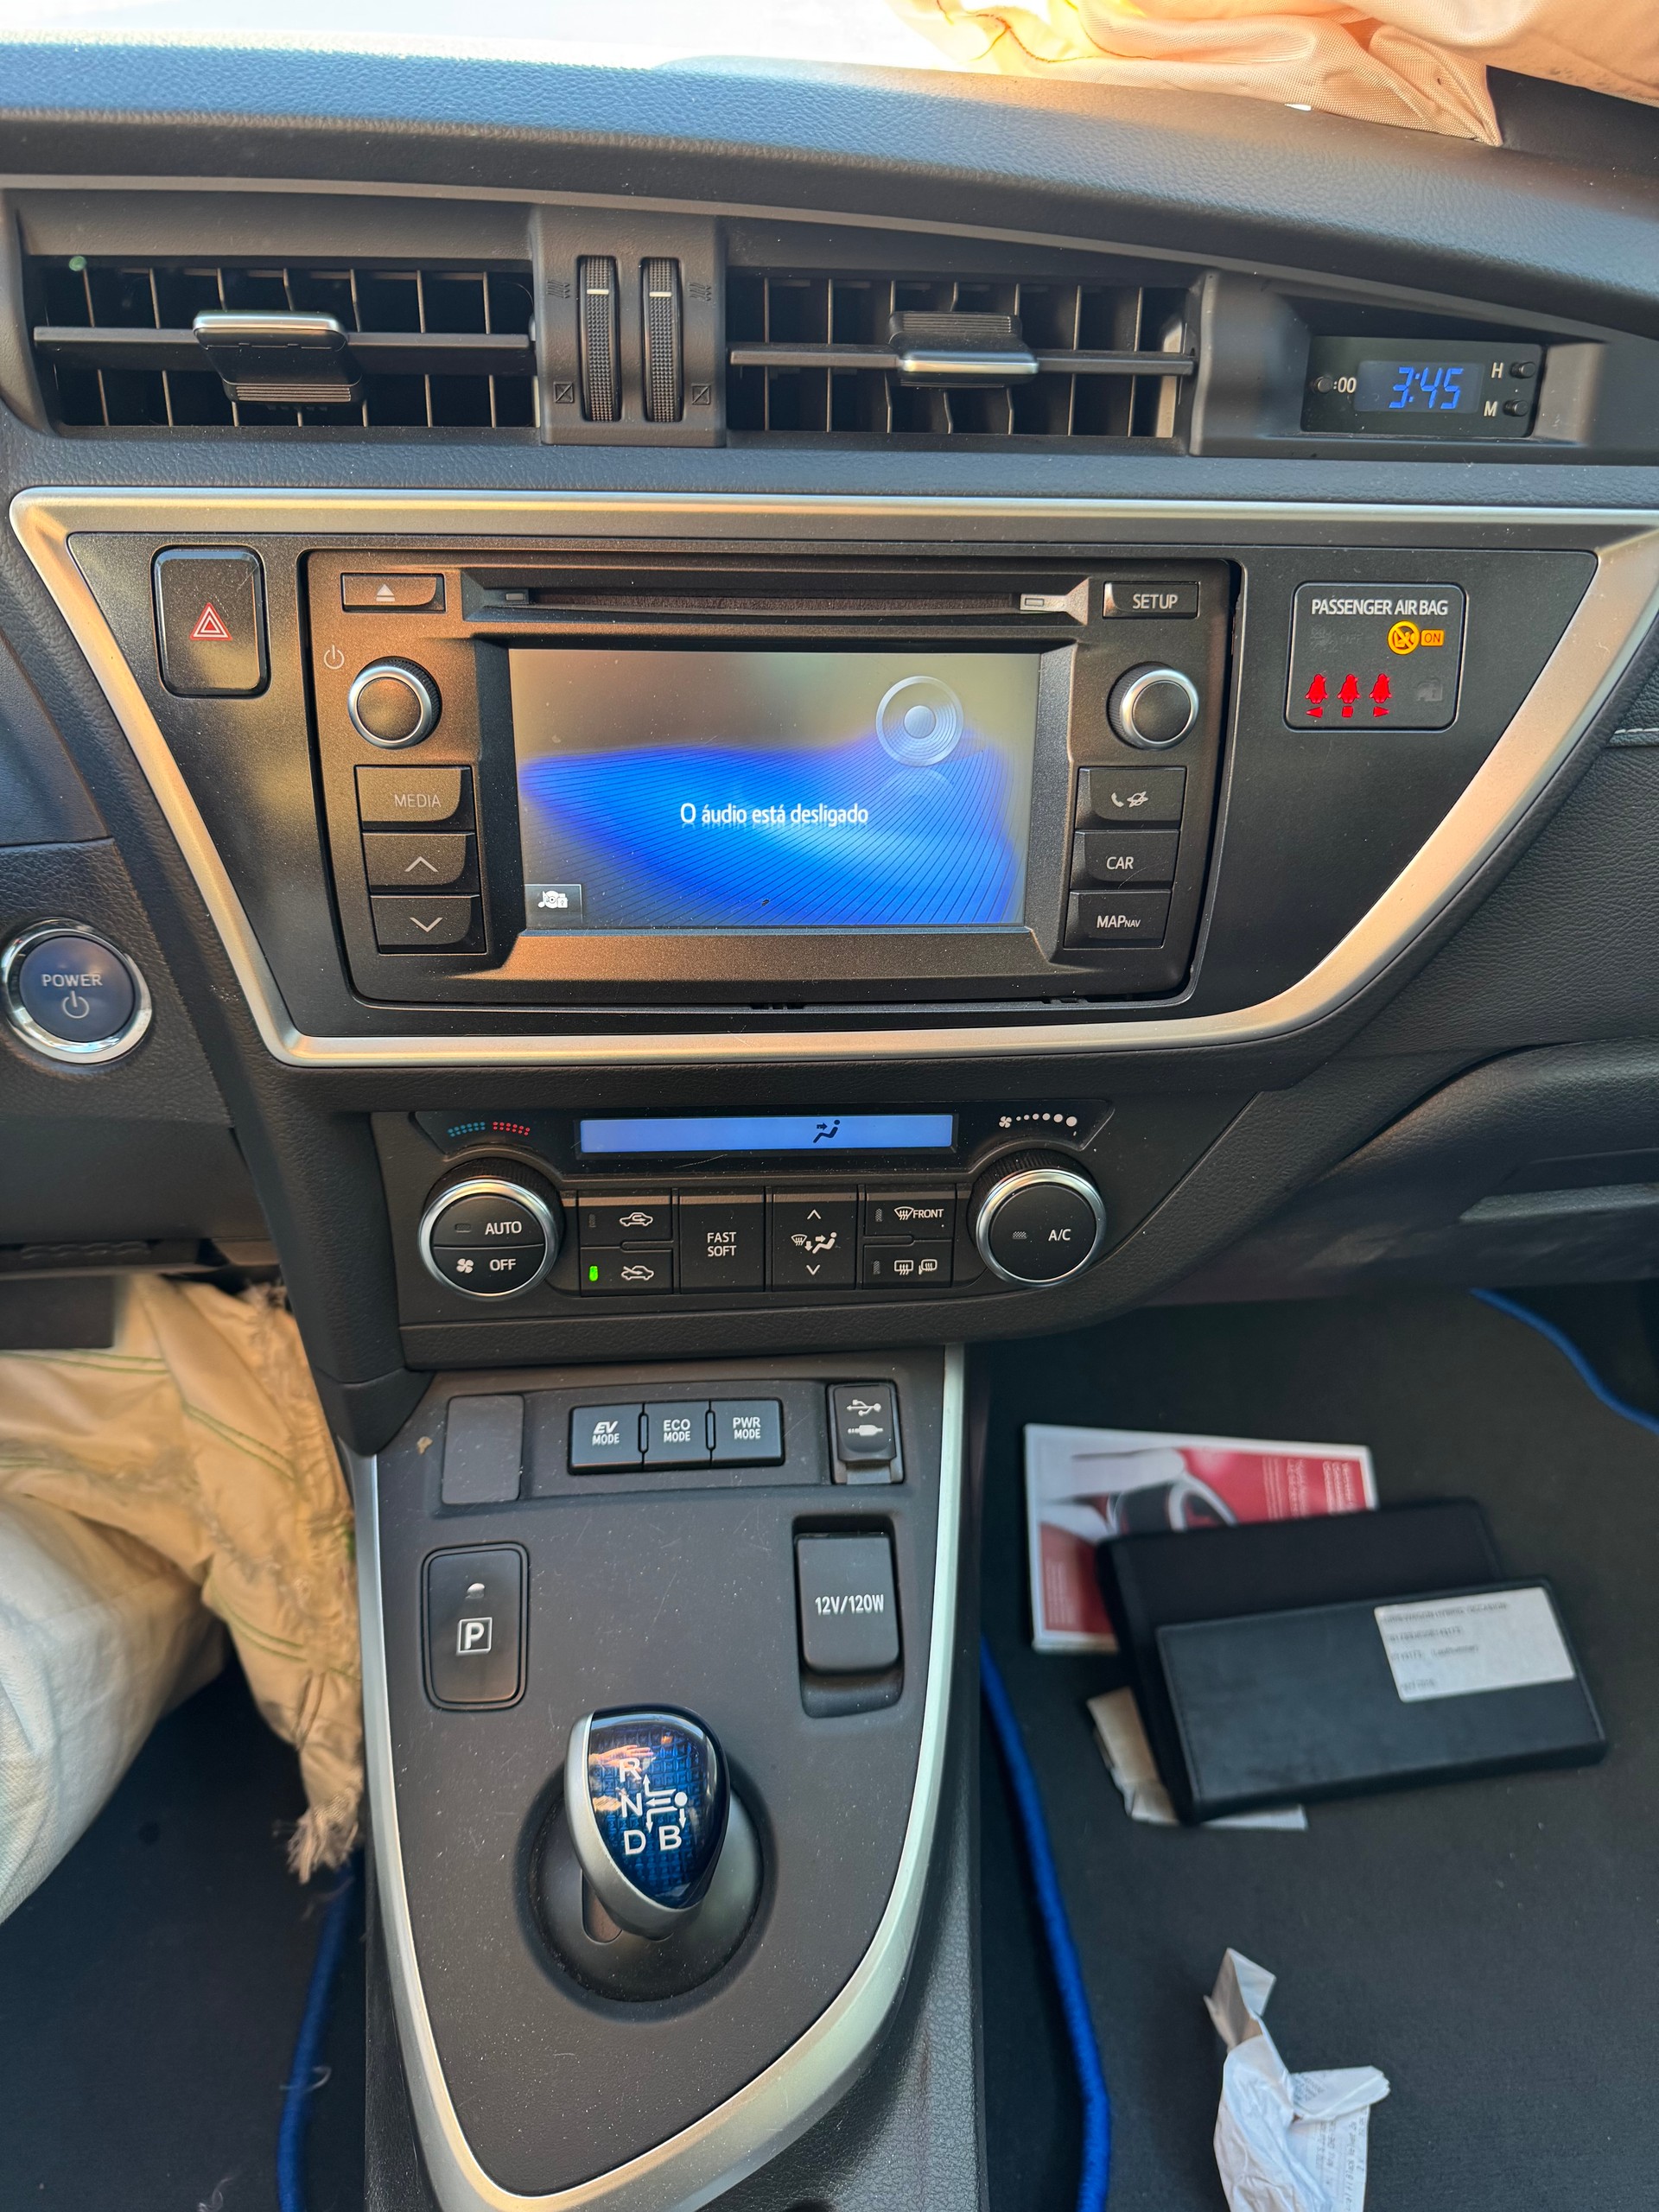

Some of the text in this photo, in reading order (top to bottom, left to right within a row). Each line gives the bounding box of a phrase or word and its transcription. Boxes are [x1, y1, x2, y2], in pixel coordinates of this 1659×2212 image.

[1491, 362, 1503, 379] H
[1389, 366, 1464, 410] 3:45
[1484, 401, 1497, 417] M
[1132, 594, 1179, 610] SETUP
[1311, 598, 1392, 615] PASSENGER
[1424, 632, 1441, 644] ON
[393, 793, 442, 810] MEDIA
[680, 802, 869, 828] O áudio está desligado
[1105, 856, 1135, 870] CAR
[41, 974, 103, 987] POWER
[912, 1207, 944, 1219] FRONT
[485, 1220, 523, 1236] AUTO
[707, 1231, 737, 1243] FAST
[1048, 1229, 1071, 1243] A/C
[707, 1245, 737, 1257] SOFT
[489, 1257, 517, 1272] OFF
[593, 1421, 619, 1434] EV
[663, 1418, 691, 1432] ECO
[733, 1416, 761, 1429] PWR
[592, 1433, 620, 1446] MODE
[663, 1430, 691, 1443] MODE
[734, 1428, 761, 1440] MODE
[815, 1593, 885, 1615] 12V/120W
[463, 1621, 485, 1649] P
[619, 1758, 642, 1783] R
[620, 1792, 643, 1818] N
[623, 1824, 682, 1855] D B
